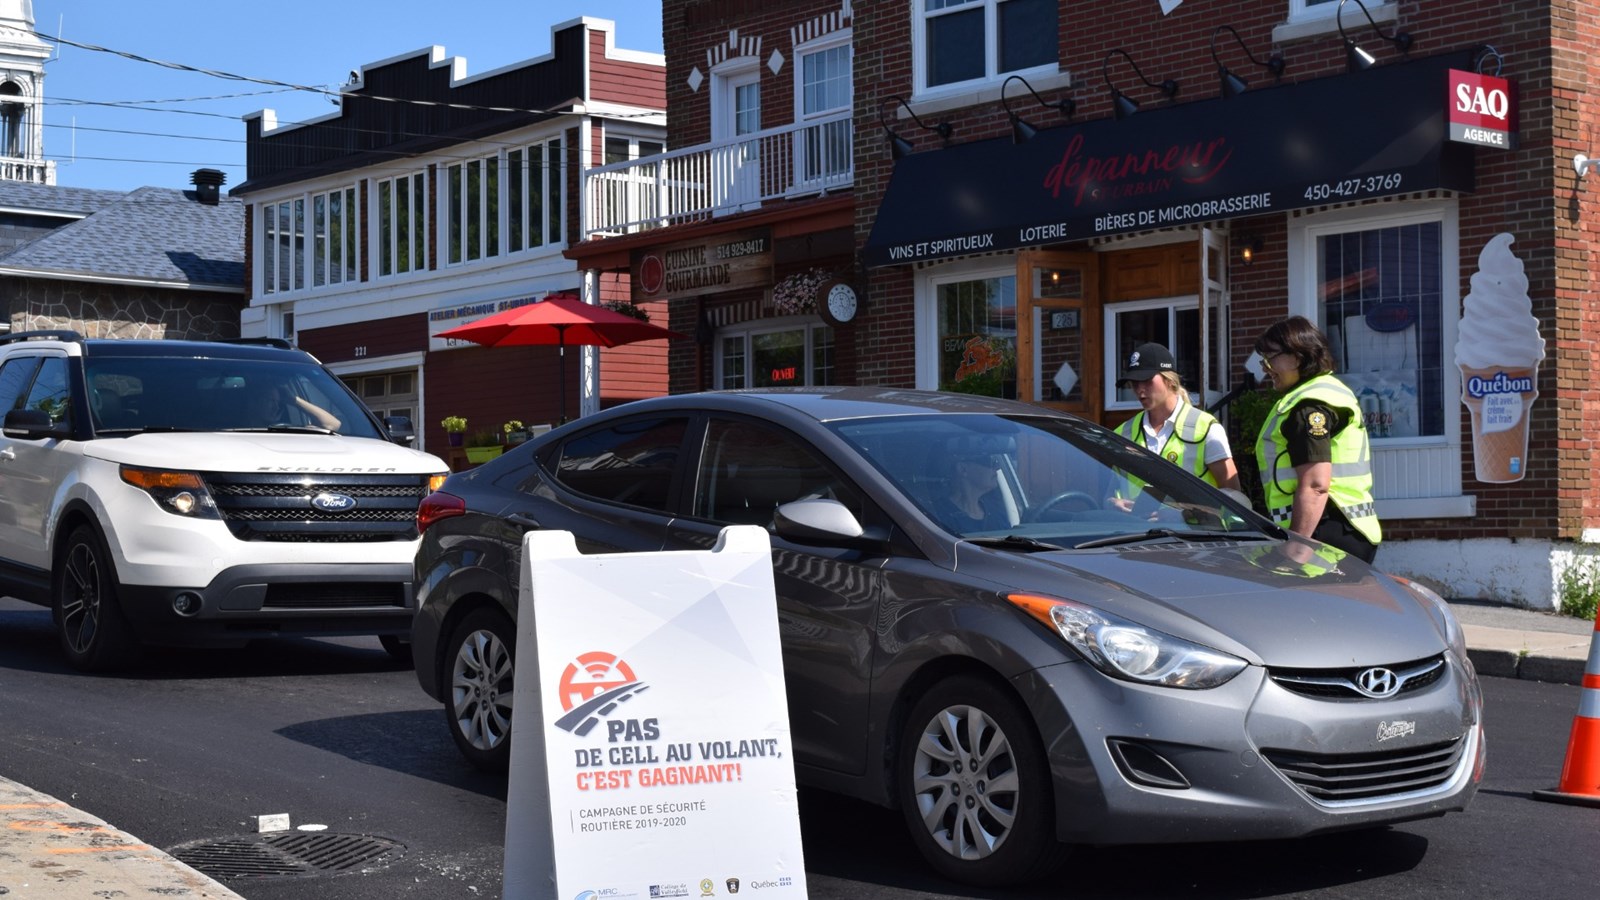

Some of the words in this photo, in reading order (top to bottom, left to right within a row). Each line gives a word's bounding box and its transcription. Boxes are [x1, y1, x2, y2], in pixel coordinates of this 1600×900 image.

[1456, 83, 1508, 120] SAQ
[1463, 128, 1503, 144] AGENCE
[1043, 134, 1235, 207] dépanneur
[1304, 173, 1402, 200] 450-427-3769
[1095, 212, 1136, 232] BIÈRES
[1138, 210, 1156, 225] DE
[1158, 193, 1271, 222] MICROBRASSERIE
[1020, 223, 1067, 242] LOTERIE
[731, 239, 764, 257] 929-8417
[889, 244, 914, 260] VINS
[916, 242, 930, 257] ET
[930, 234, 994, 254] SPIRITUEUX
[665, 245, 707, 271] CUISINE
[665, 263, 731, 292] GOURMANDE
[430, 310, 455, 321] ATELIER
[457, 303, 495, 320] MÉCANIQUE
[1055, 313, 1073, 327] 225
[1469, 374, 1532, 397] Québon
[1487, 396, 1498, 406] Fait
[1500, 397, 1513, 406] avec
[322, 495, 347, 508] Ford
[606, 718, 660, 743] PAS
[575, 748, 604, 767] DE
[609, 745, 659, 765] CELL
[666, 743, 692, 762] AU
[698, 738, 783, 760] VOLANT,
[576, 770, 632, 791] C'EST
[638, 763, 742, 787] GAGNANT!
[579, 805, 638, 819] CAMPAGNE
[640, 804, 654, 815] DE
[656, 800, 706, 814] SÉCURITÉ
[580, 819, 633, 833] ROUTIÈRE
[635, 816, 687, 829] 2019-2020
[597, 887, 618, 896] MRC
[751, 879, 779, 889] Québec
